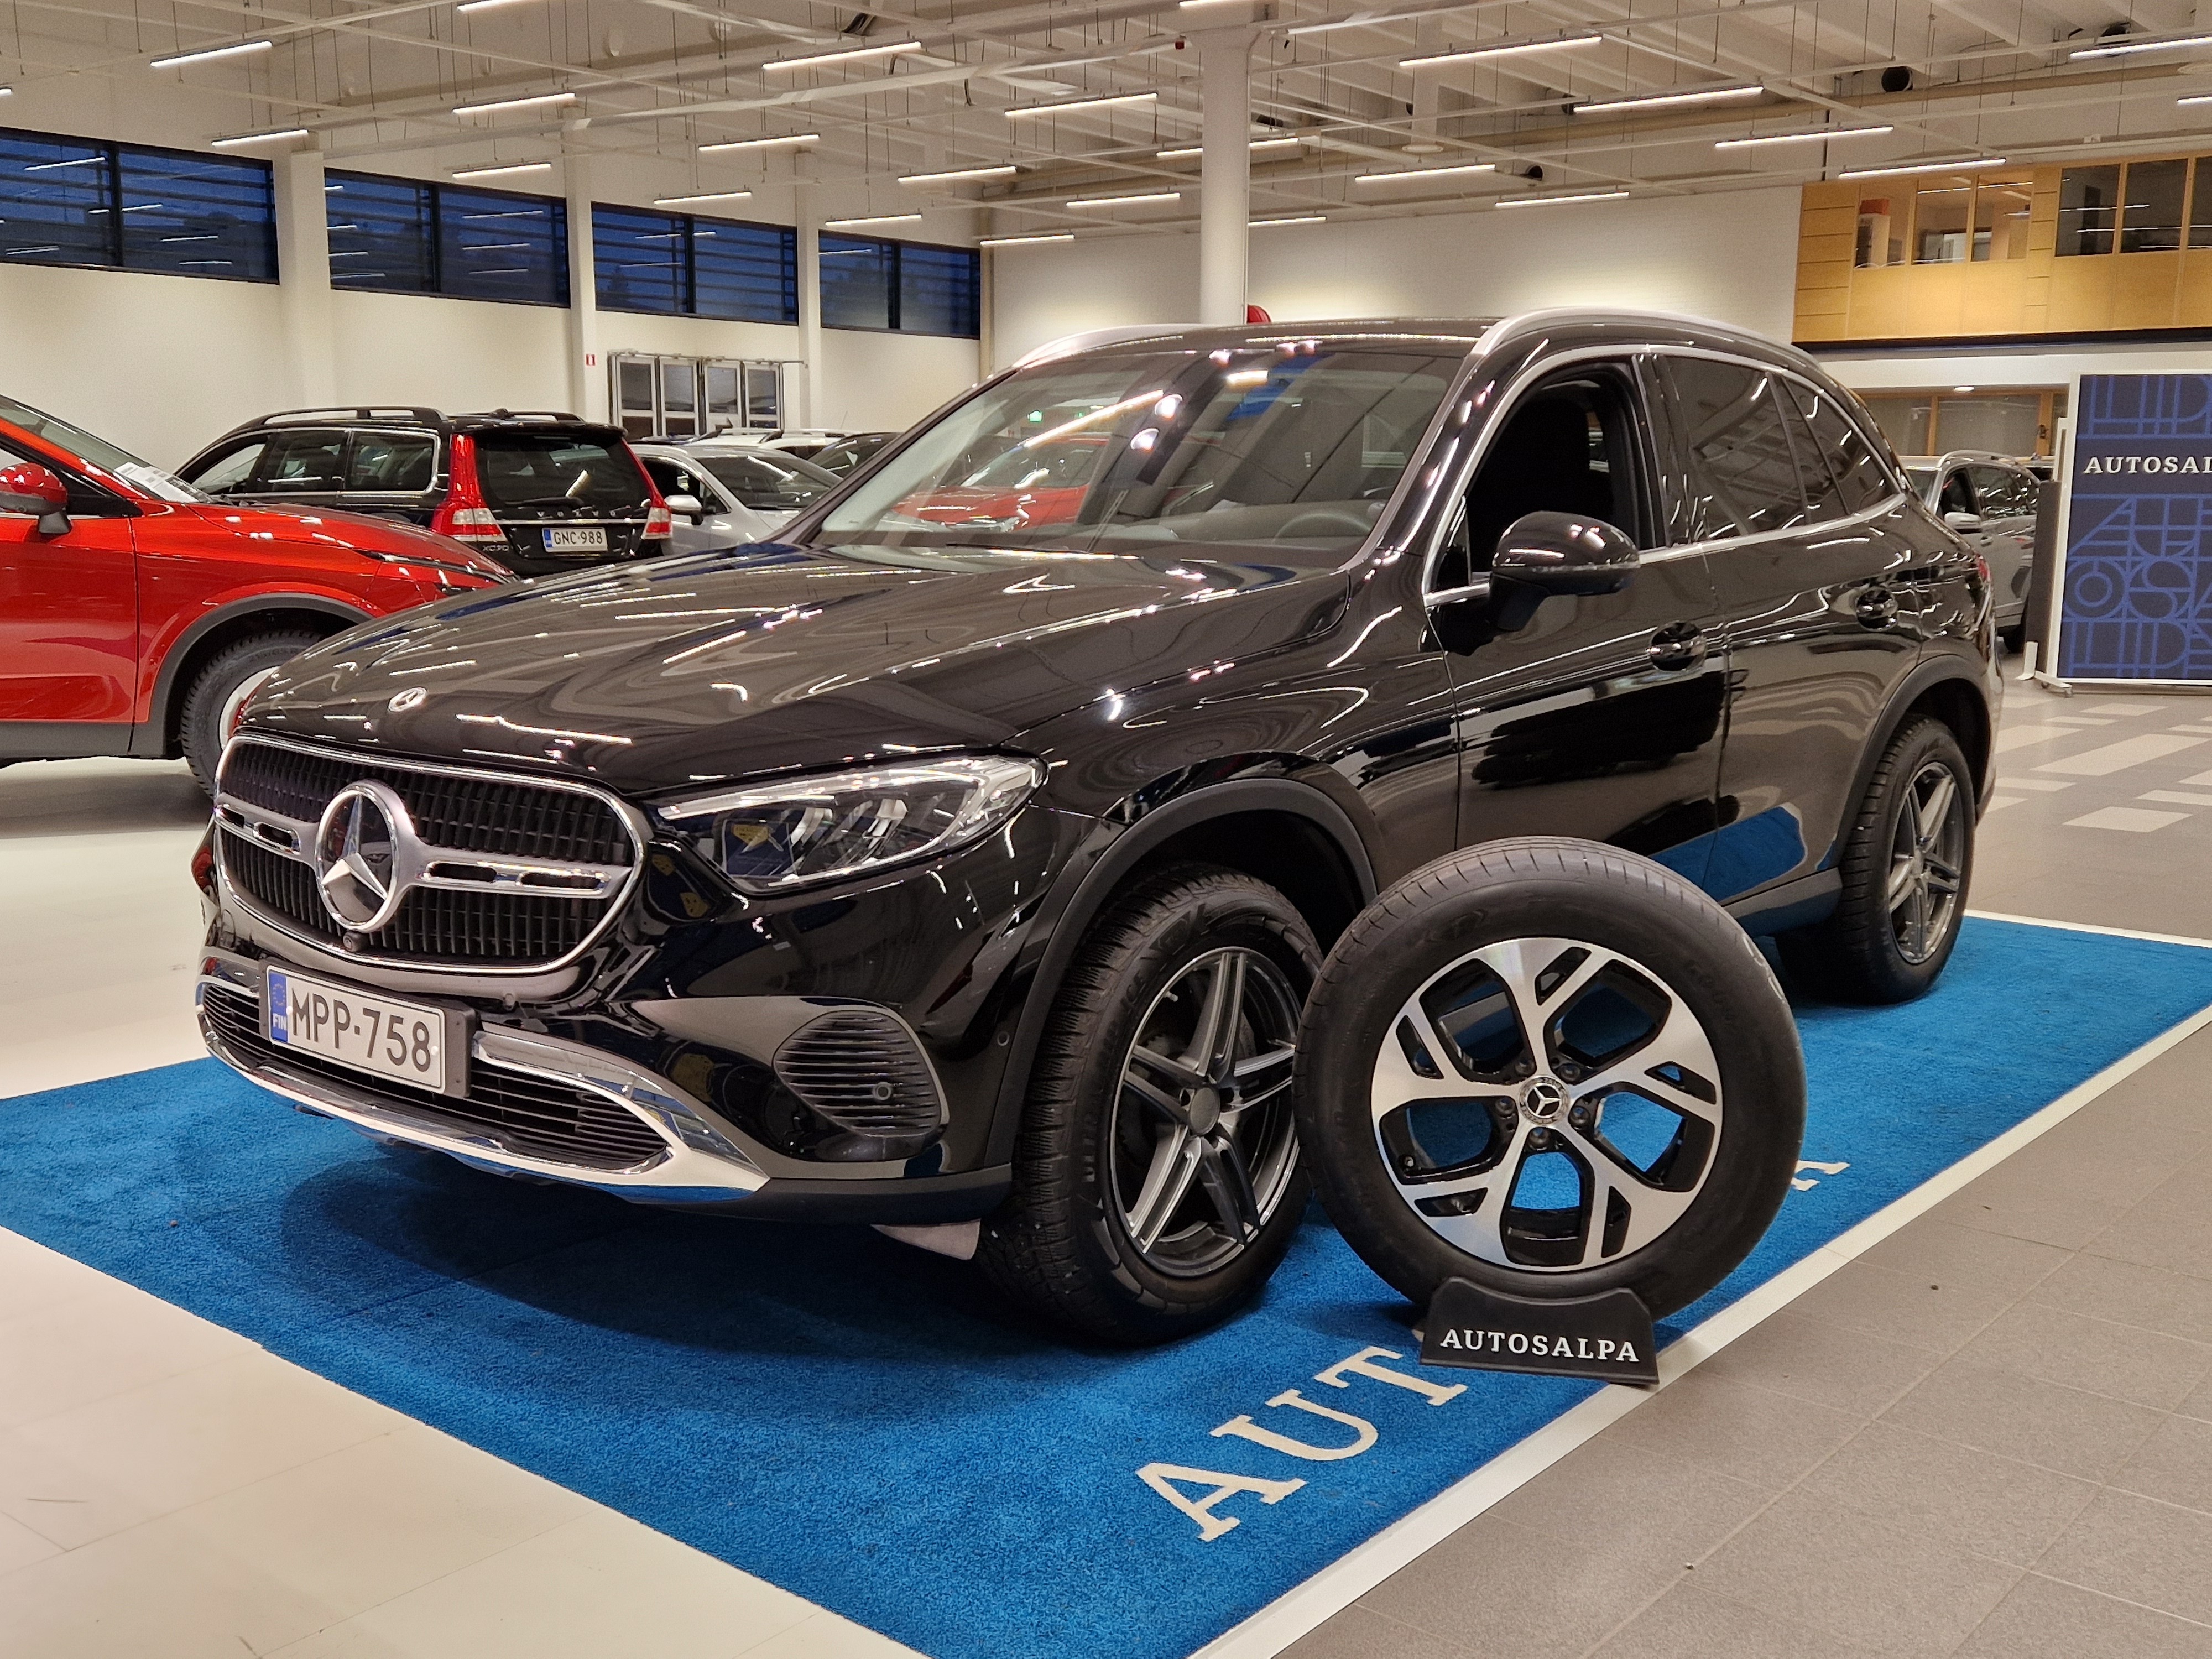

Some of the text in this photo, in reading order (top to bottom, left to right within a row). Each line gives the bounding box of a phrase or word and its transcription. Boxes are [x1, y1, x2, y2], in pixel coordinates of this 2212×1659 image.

[273, 1013, 288, 1031] FIN
[292, 988, 431, 1072] MPP-758
[1439, 1329, 1639, 1362] AUTOSALPA
[1135, 1345, 1468, 1542] AUT
